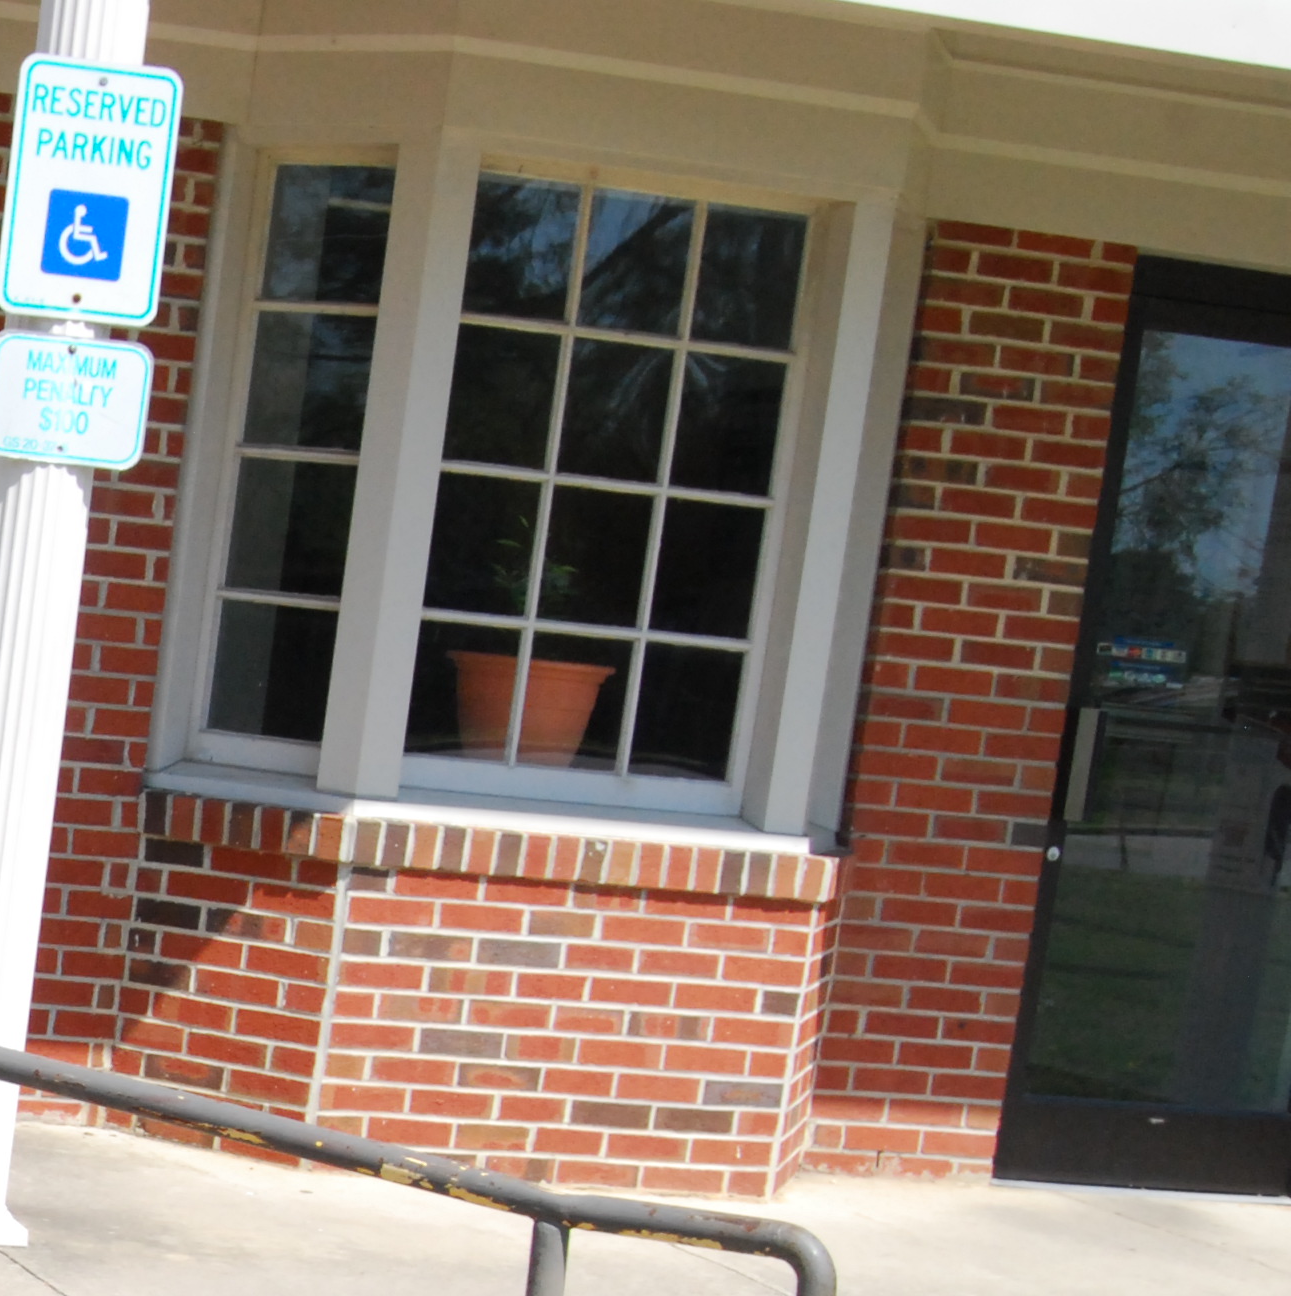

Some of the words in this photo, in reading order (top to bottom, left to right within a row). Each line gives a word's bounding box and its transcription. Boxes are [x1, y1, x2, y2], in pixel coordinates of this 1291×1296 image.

[31, 83, 167, 128] RESERVED
[35, 128, 153, 170] PARKING
[26, 349, 119, 380] MAXMUM
